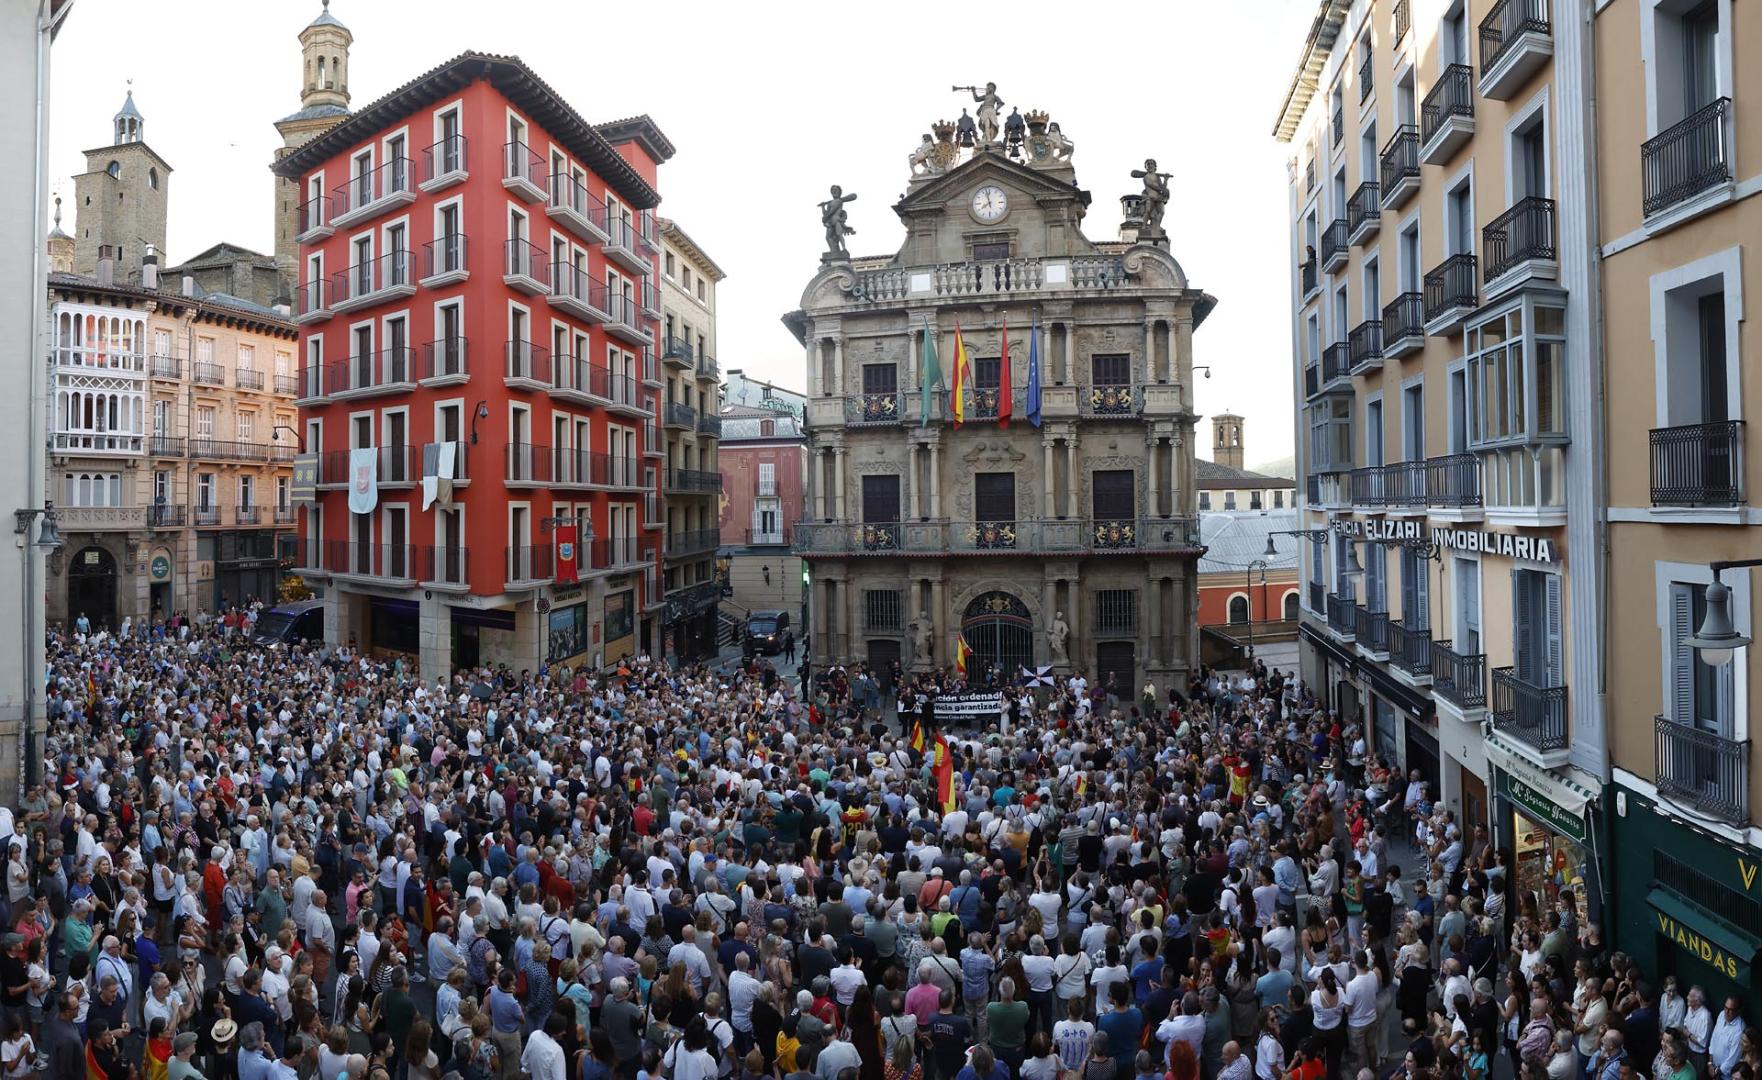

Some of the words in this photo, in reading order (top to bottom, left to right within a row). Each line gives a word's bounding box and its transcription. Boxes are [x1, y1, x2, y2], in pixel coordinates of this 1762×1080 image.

[1328, 519, 1360, 536] GENCIA
[1365, 519, 1421, 542] ELIZARI
[1431, 528, 1551, 562] INMOBILIARIA
[1658, 912, 1738, 979] VIANDAS
